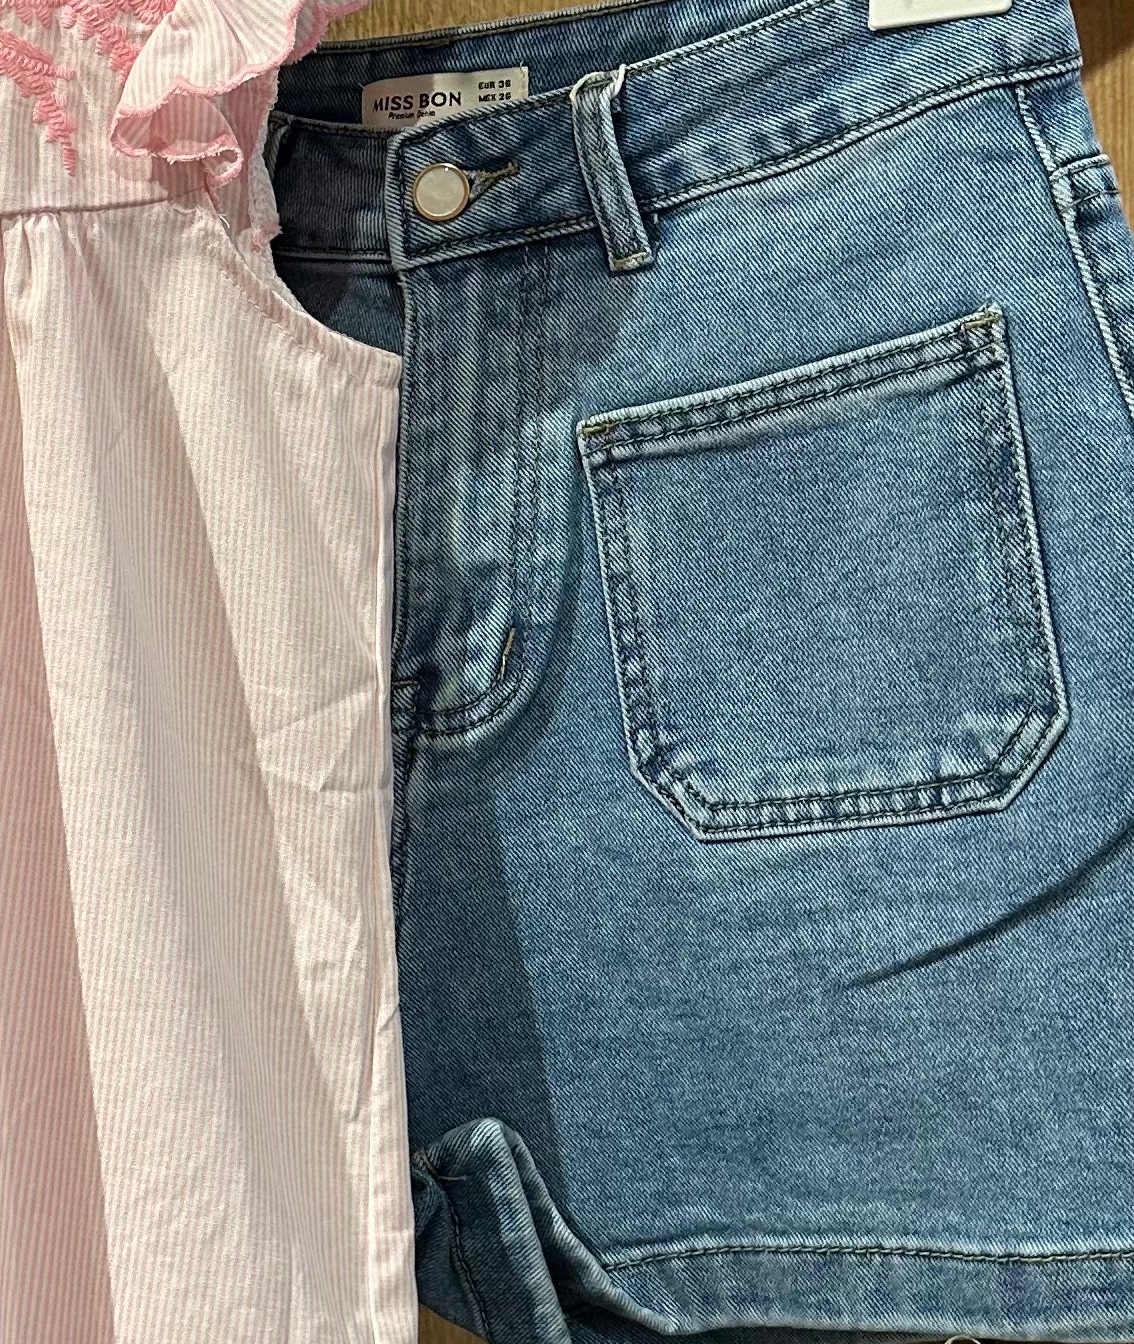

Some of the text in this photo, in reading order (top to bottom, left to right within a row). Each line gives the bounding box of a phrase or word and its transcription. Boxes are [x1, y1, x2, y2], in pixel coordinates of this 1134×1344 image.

[478, 81, 496, 90] EUR
[372, 91, 462, 113] MISS BON
